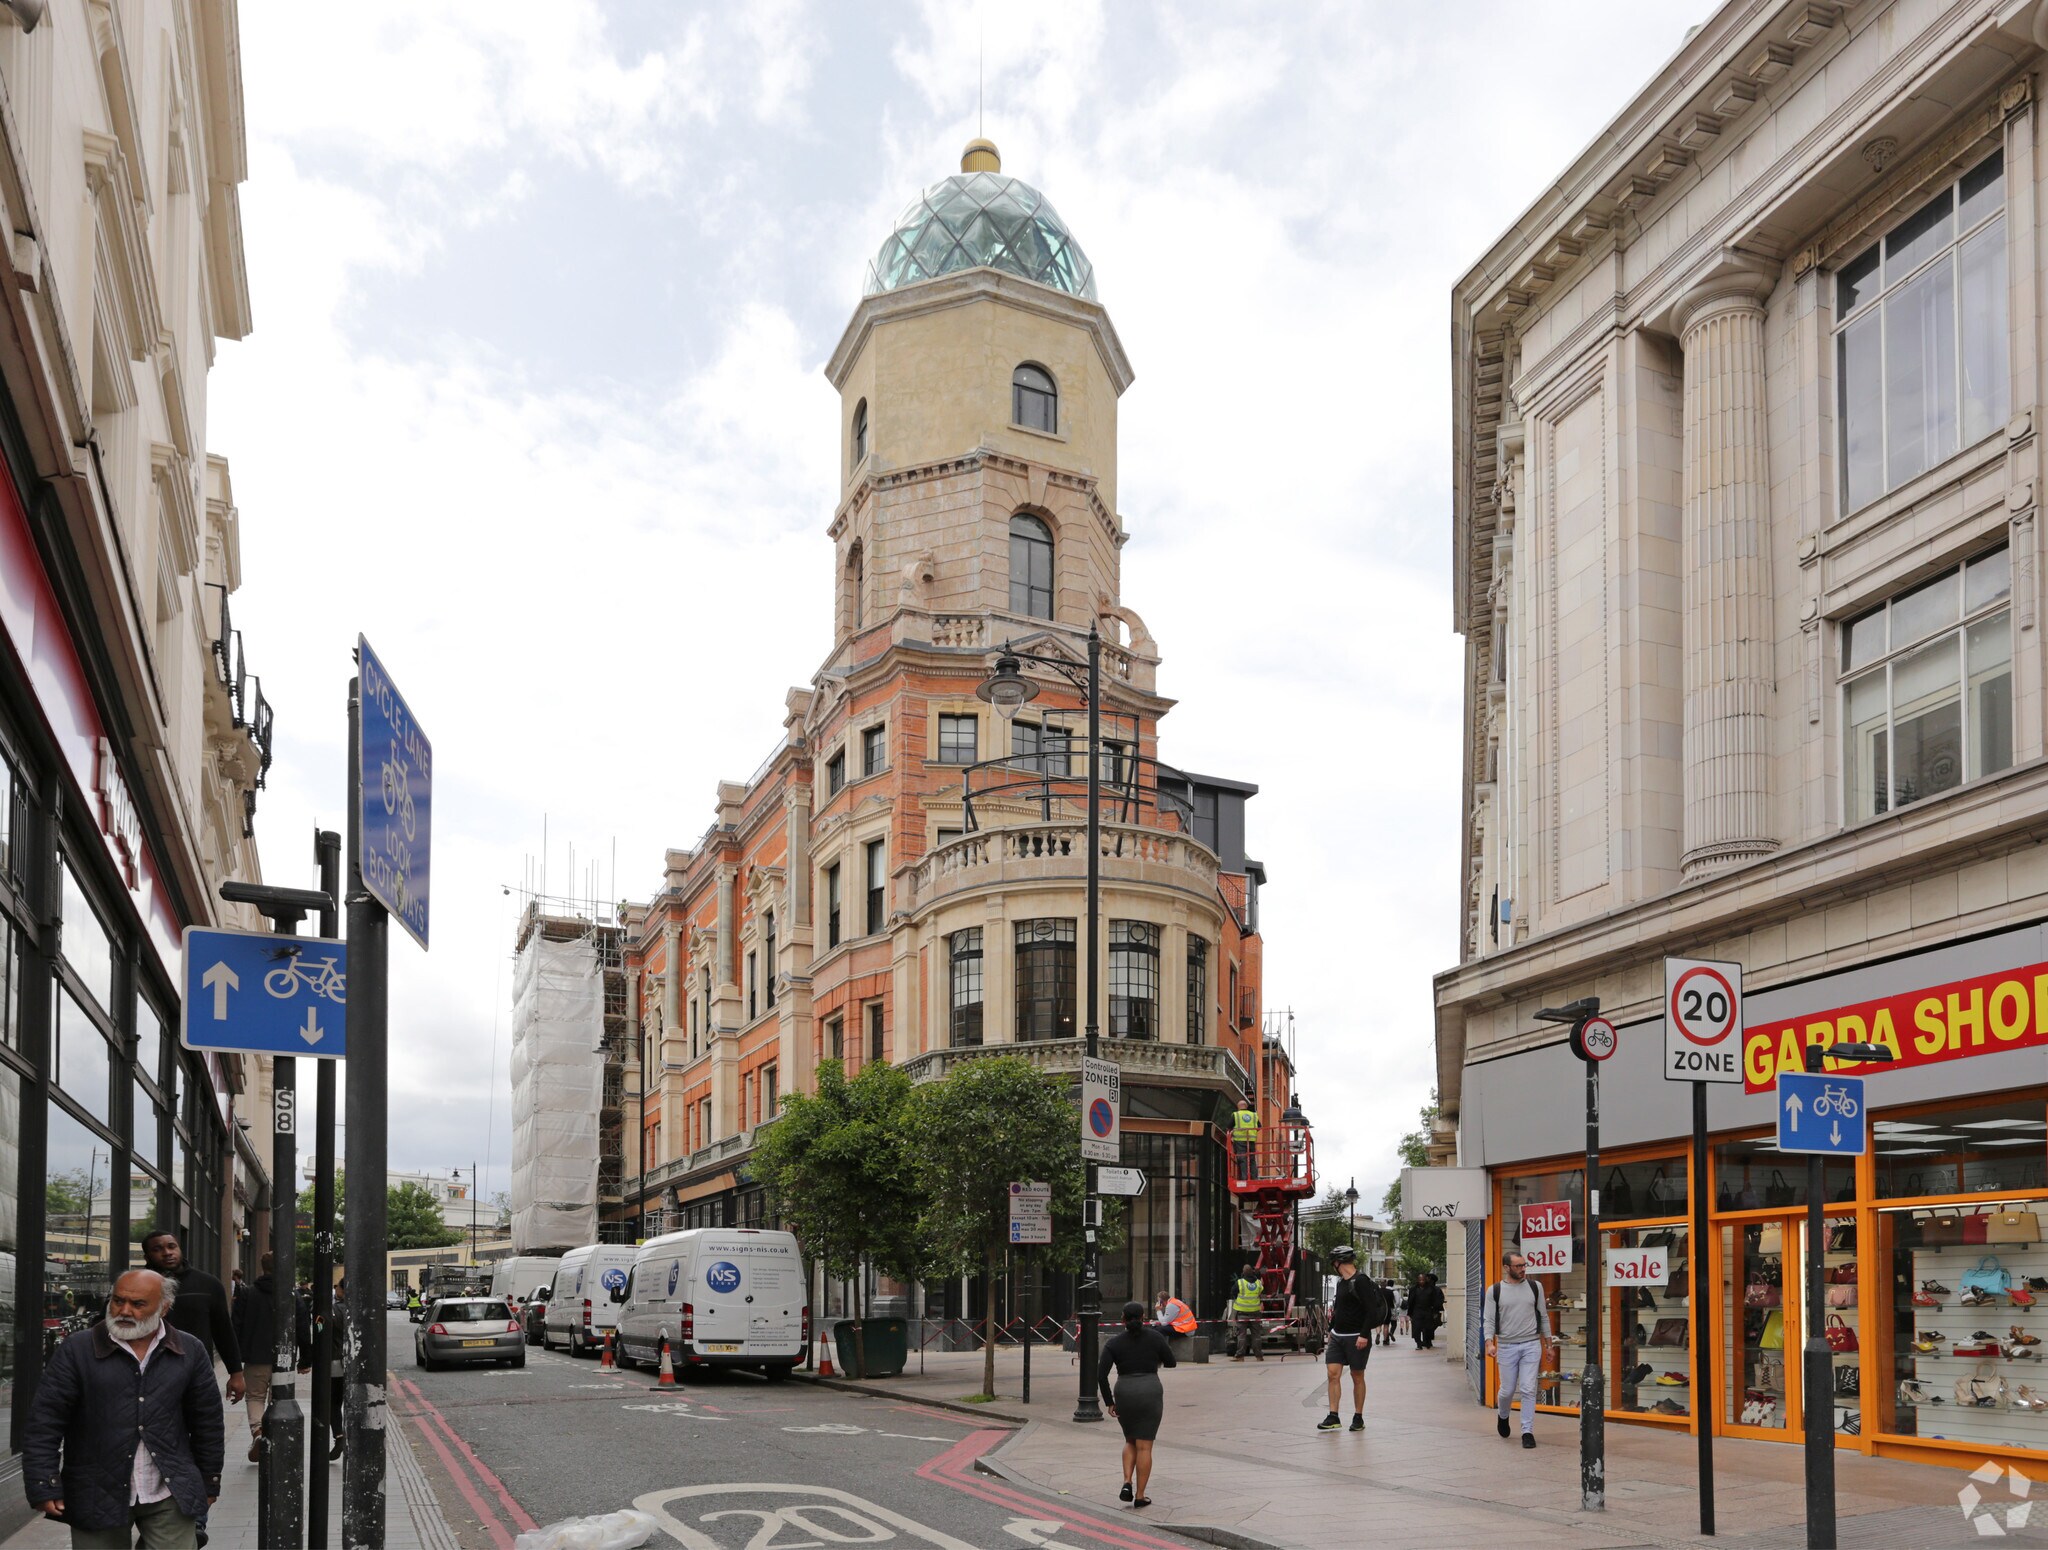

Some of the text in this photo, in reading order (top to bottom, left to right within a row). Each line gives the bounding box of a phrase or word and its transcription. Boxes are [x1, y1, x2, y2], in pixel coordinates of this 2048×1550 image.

[365, 661, 429, 780] CYCLE LANE
[386, 823, 412, 880] LOOK
[369, 846, 424, 932] BOTH WAYS
[1683, 990, 1727, 1023] 20
[1744, 1007, 1902, 1086] GARDA
[1085, 1060, 1118, 1075] Controlled
[1674, 1051, 1734, 1072] ZONE
[1085, 1071, 1108, 1086] ZONE
[1526, 1208, 1566, 1234] sale
[708, 1245, 789, 1254] www.signs-nis.co.uk
[1527, 1244, 1566, 1267] sale
[1614, 1254, 1662, 1279] sale
[699, 1504, 896, 1550] 20
